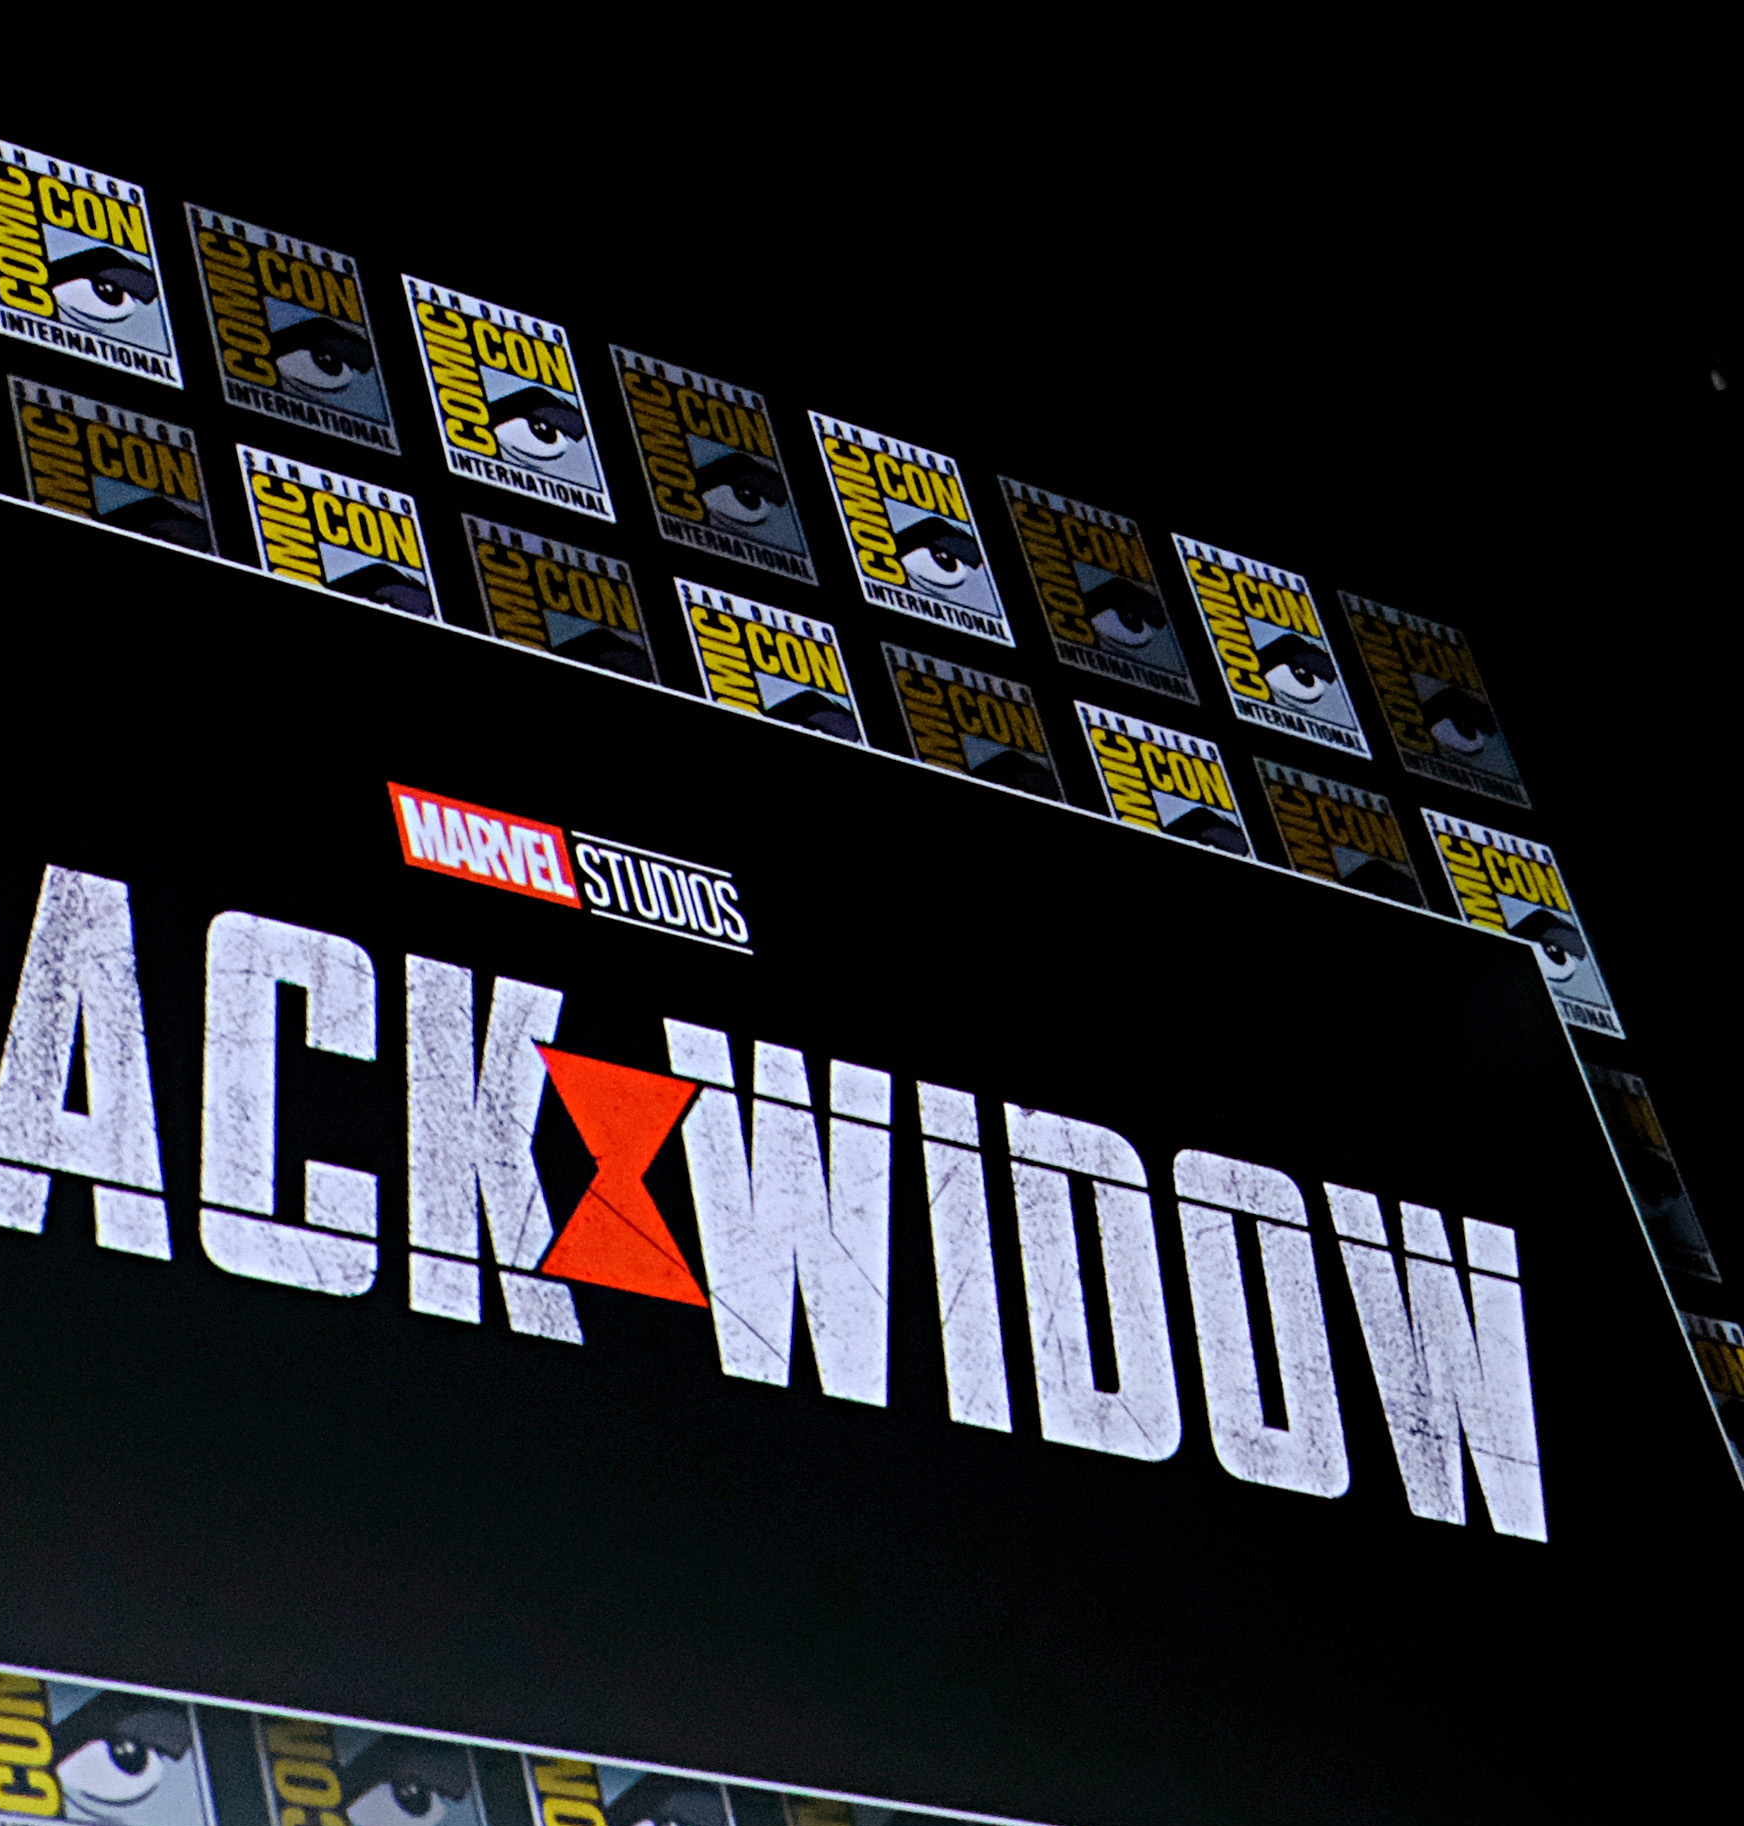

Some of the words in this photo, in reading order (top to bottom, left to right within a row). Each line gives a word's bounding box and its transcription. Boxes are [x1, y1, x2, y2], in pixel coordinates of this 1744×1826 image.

[35, 174, 151, 257] CON
[47, 160, 141, 204] DIEGO
[0, 308, 178, 383] INTERNATIONAL
[415, 300, 500, 458] COMIC
[470, 317, 577, 395] CON
[449, 448, 611, 518] INTERNATIONAL
[822, 435, 908, 588] COMIC
[872, 451, 972, 525] CON
[863, 579, 1011, 643] INTERNATIONAL
[1185, 556, 1273, 703] COMIC
[1231, 571, 1324, 641] CON
[1138, 740, 1234, 812] CON
[398, 794, 575, 899] MARVEL
[575, 842, 750, 945] STUDIOS
[662, 1017, 1548, 1544] WIDOW
